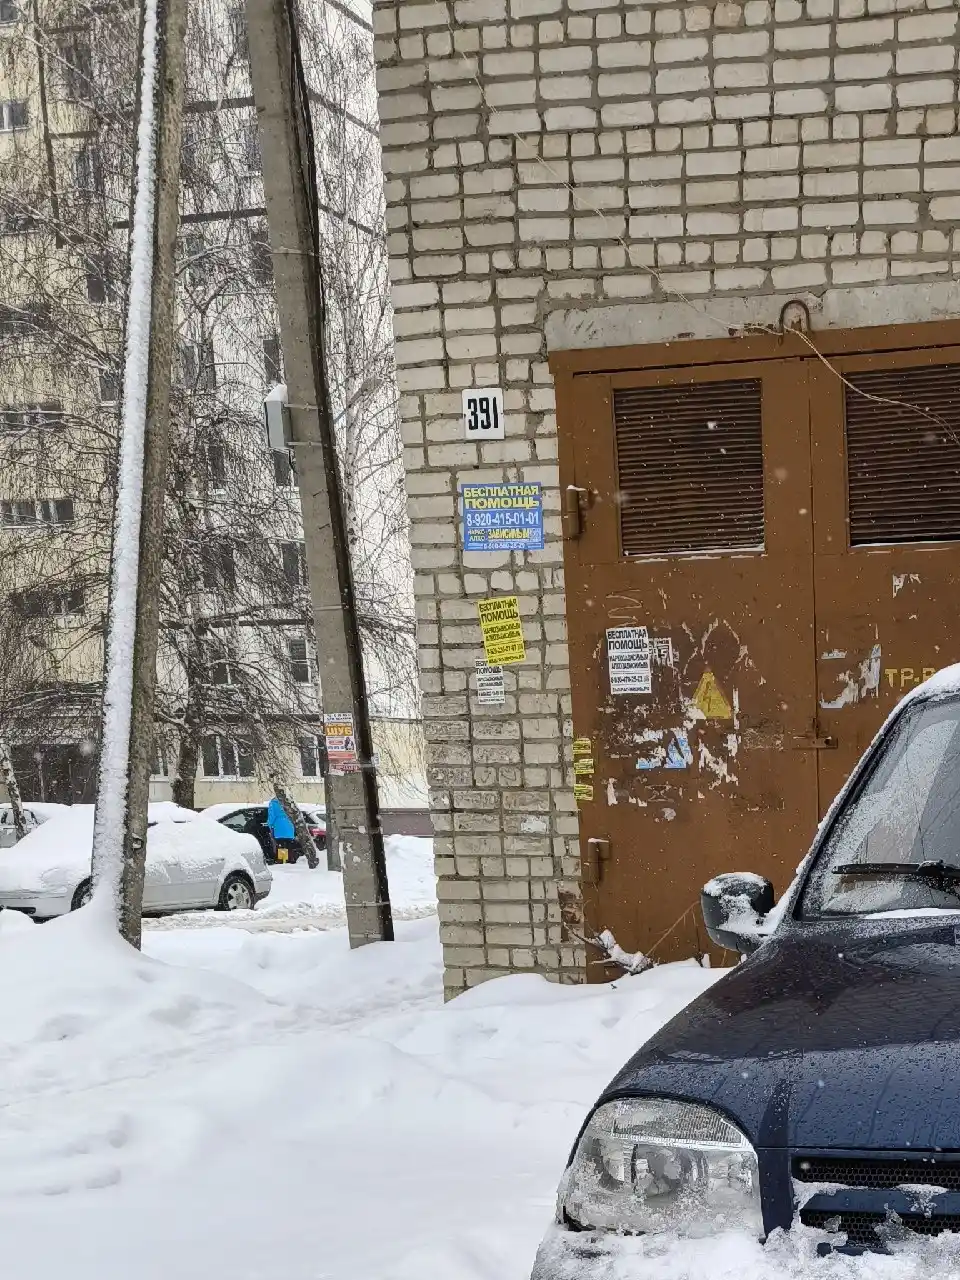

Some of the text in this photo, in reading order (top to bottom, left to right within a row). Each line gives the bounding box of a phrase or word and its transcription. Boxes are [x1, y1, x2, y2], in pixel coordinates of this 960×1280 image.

[467, 397, 499, 430] 391
[463, 486, 539, 498] БЕСПЛАТНАЯ
[465, 497, 540, 509] ПОМОЩЬ
[466, 511, 539, 526] 8-920-415-01-01
[481, 609, 518, 623] ПОМОЩЬ
[607, 629, 647, 639] БЕСПЛАТНАЯ
[609, 639, 648, 651] ПОМОЩЬ
